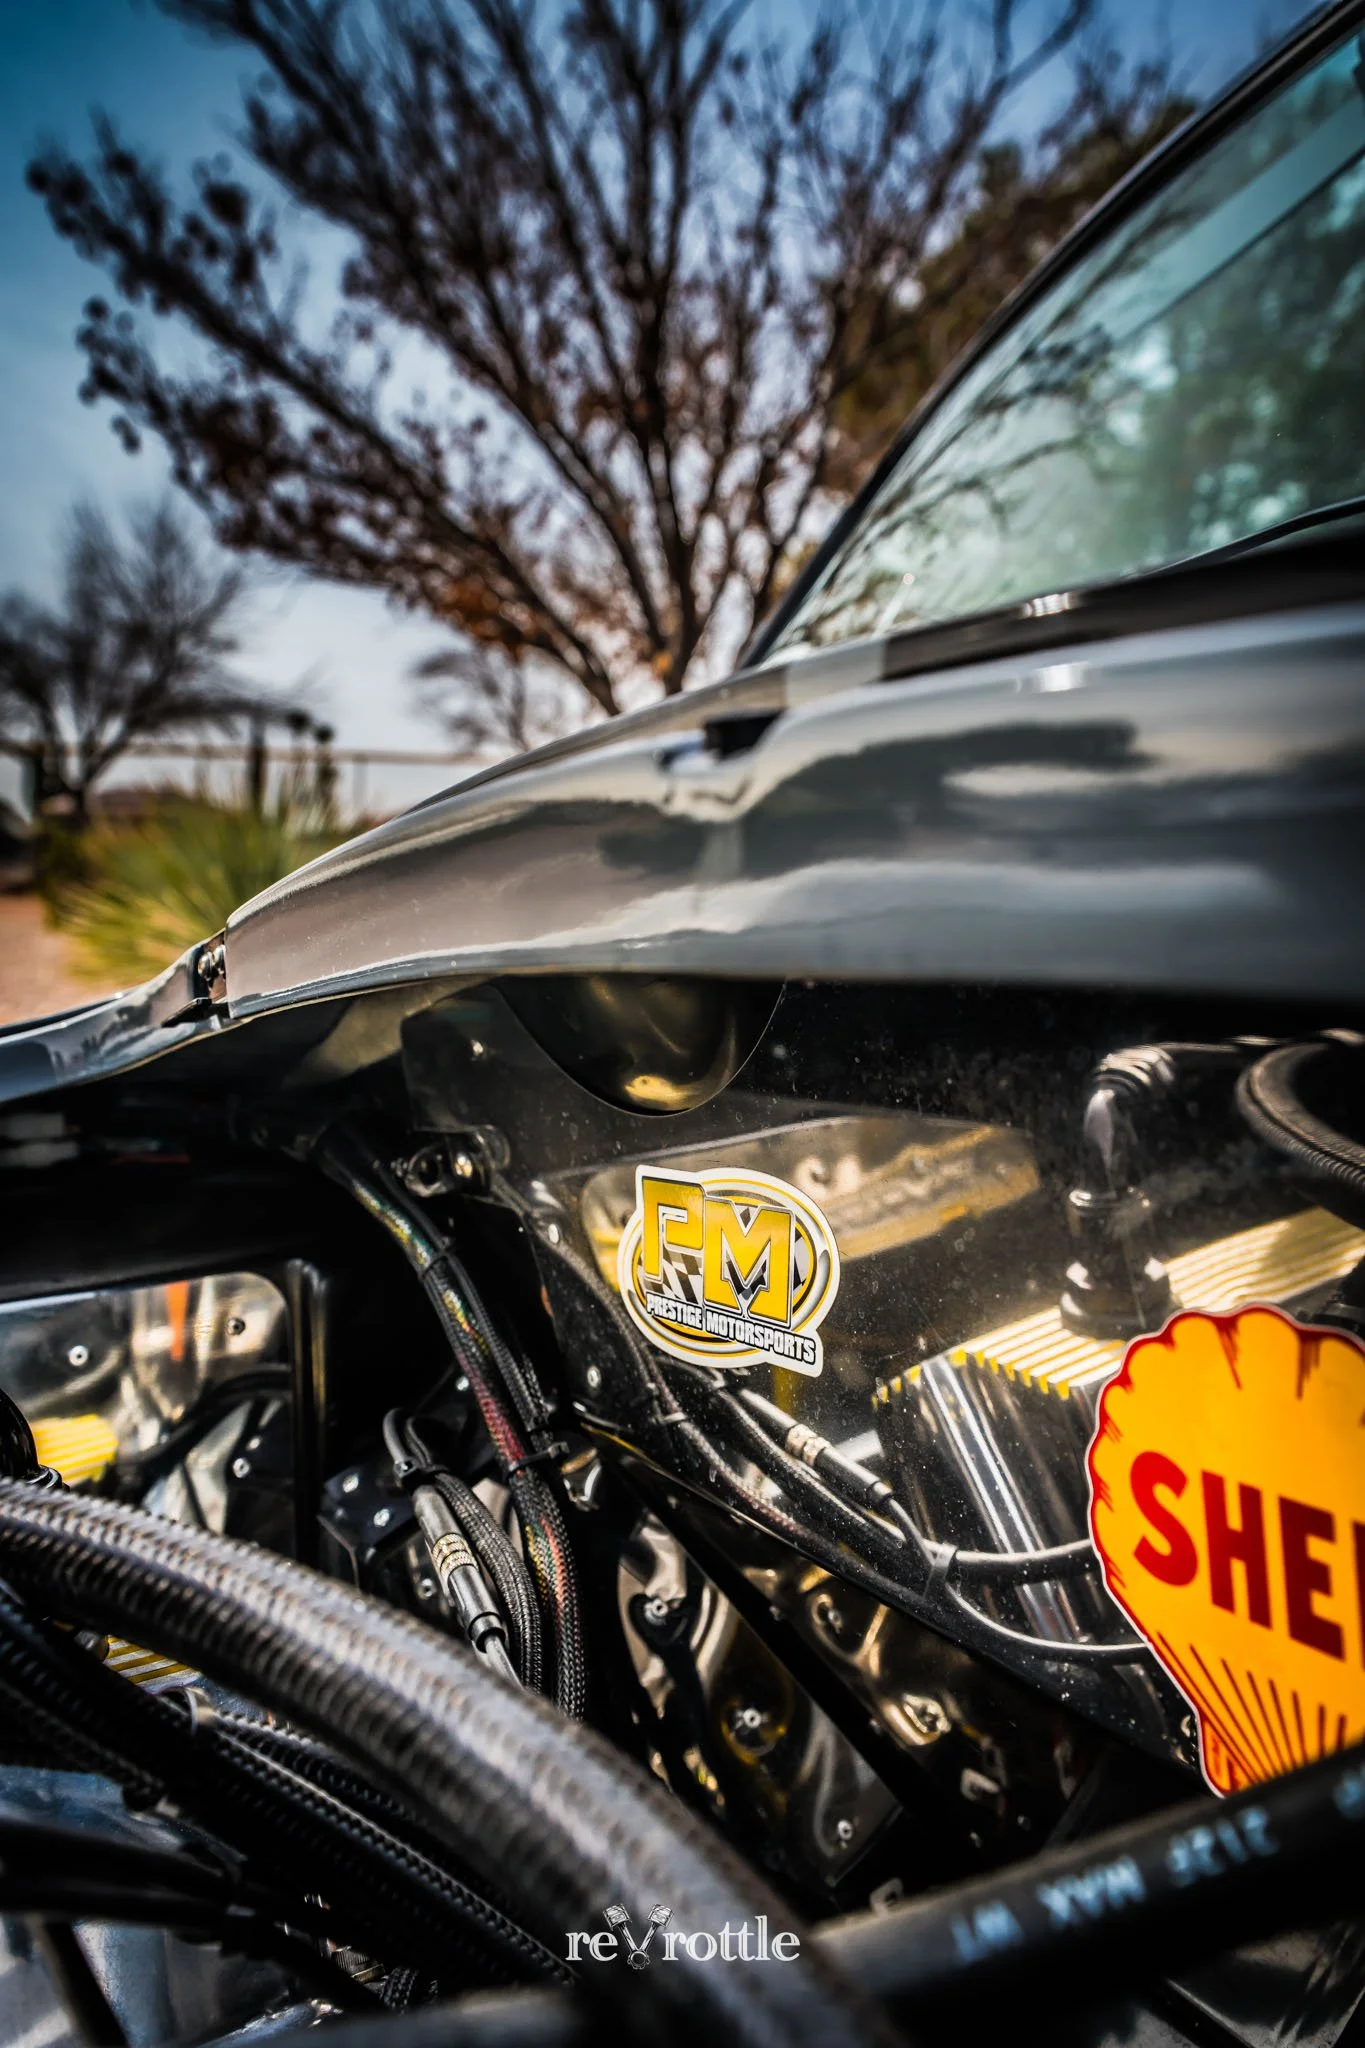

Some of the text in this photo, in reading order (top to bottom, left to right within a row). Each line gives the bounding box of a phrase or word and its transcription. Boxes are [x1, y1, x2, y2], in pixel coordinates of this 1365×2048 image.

[641, 1175, 794, 1324] PM
[646, 1292, 817, 1365] PRESTIGE MOTORSPORTS
[1130, 1450, 1365, 1673] SHE
